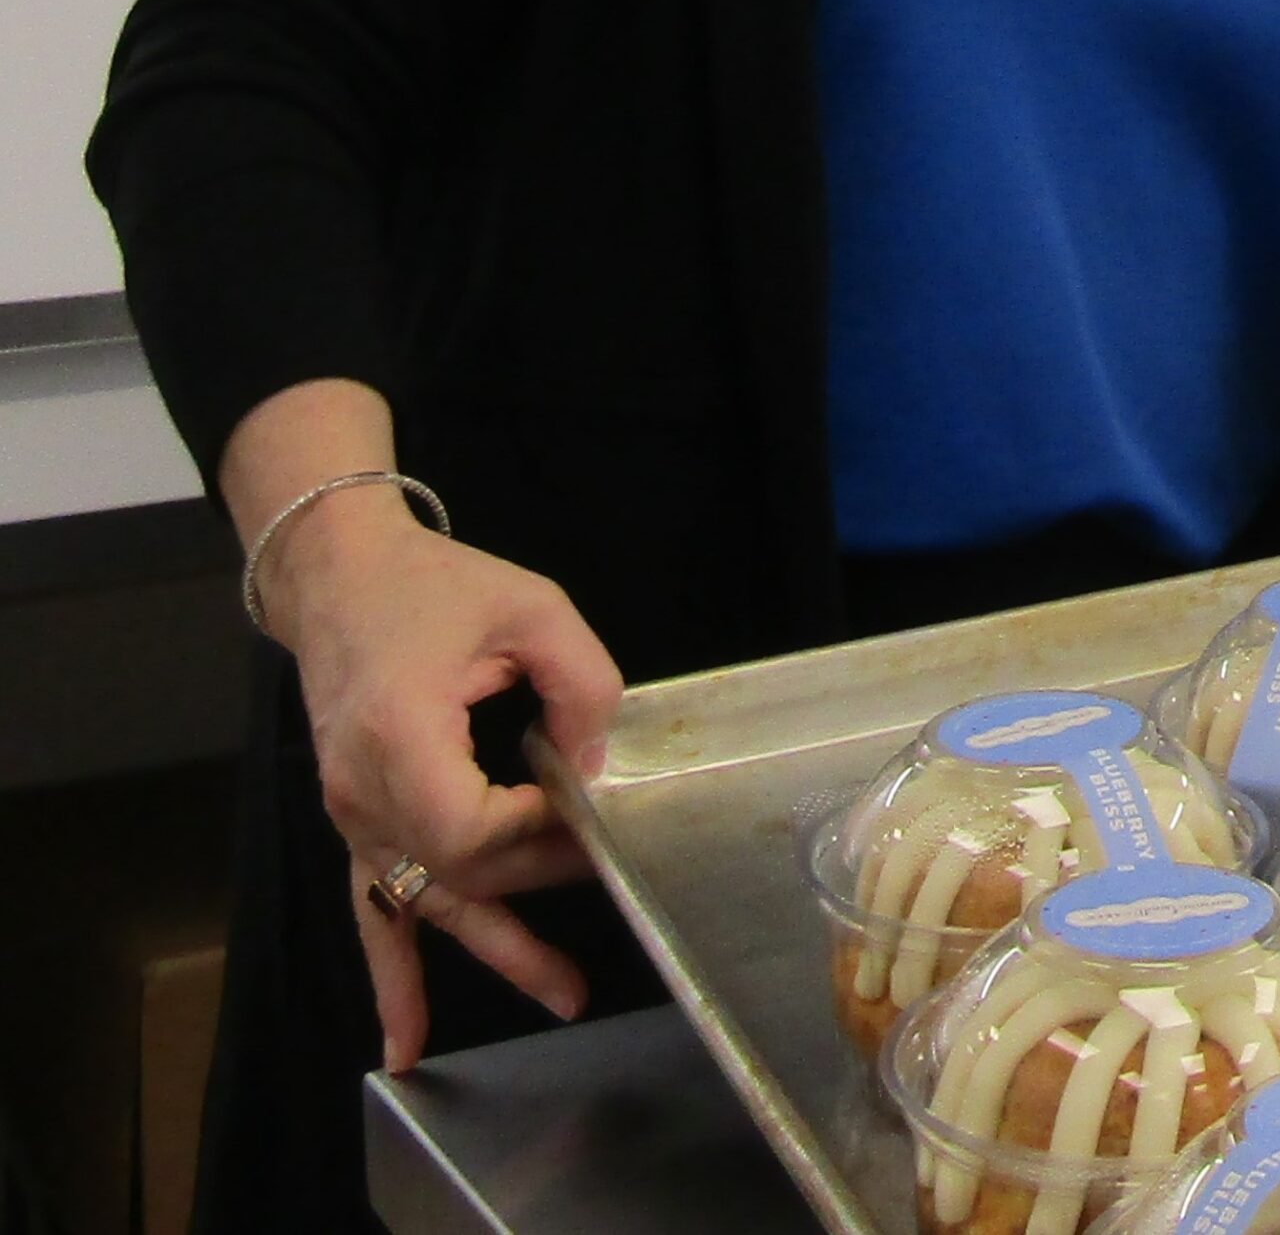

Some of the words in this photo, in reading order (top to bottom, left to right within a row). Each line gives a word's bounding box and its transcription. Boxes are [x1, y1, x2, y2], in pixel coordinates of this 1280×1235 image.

[1088, 748, 1156, 859] BLUEBERRY
[1089, 773, 1125, 831] BLISS
[1190, 1171, 1241, 1235] BLIS
